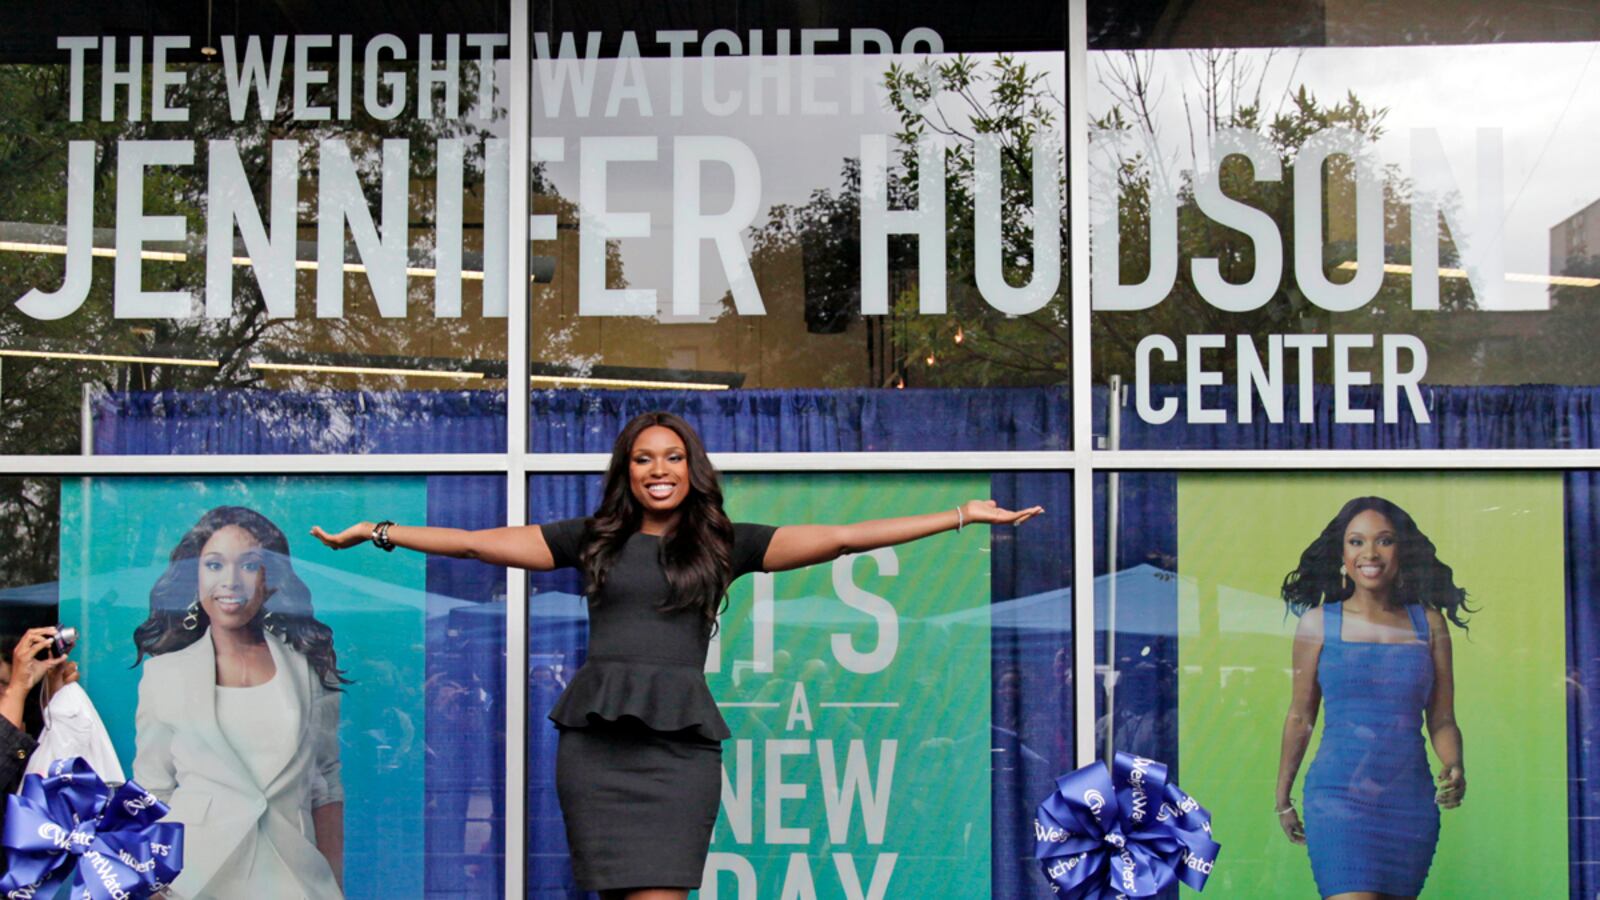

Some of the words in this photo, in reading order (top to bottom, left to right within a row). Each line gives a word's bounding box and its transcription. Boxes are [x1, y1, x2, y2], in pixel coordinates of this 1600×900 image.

[57, 35, 191, 122] THE
[221, 33, 508, 121] WEIGHT
[534, 28, 944, 118] WATCHERS
[14, 136, 767, 321] JENNIFER
[860, 127, 1503, 315] HUDSON
[1135, 334, 1430, 424] CENTER
[786, 682, 813, 731] A
